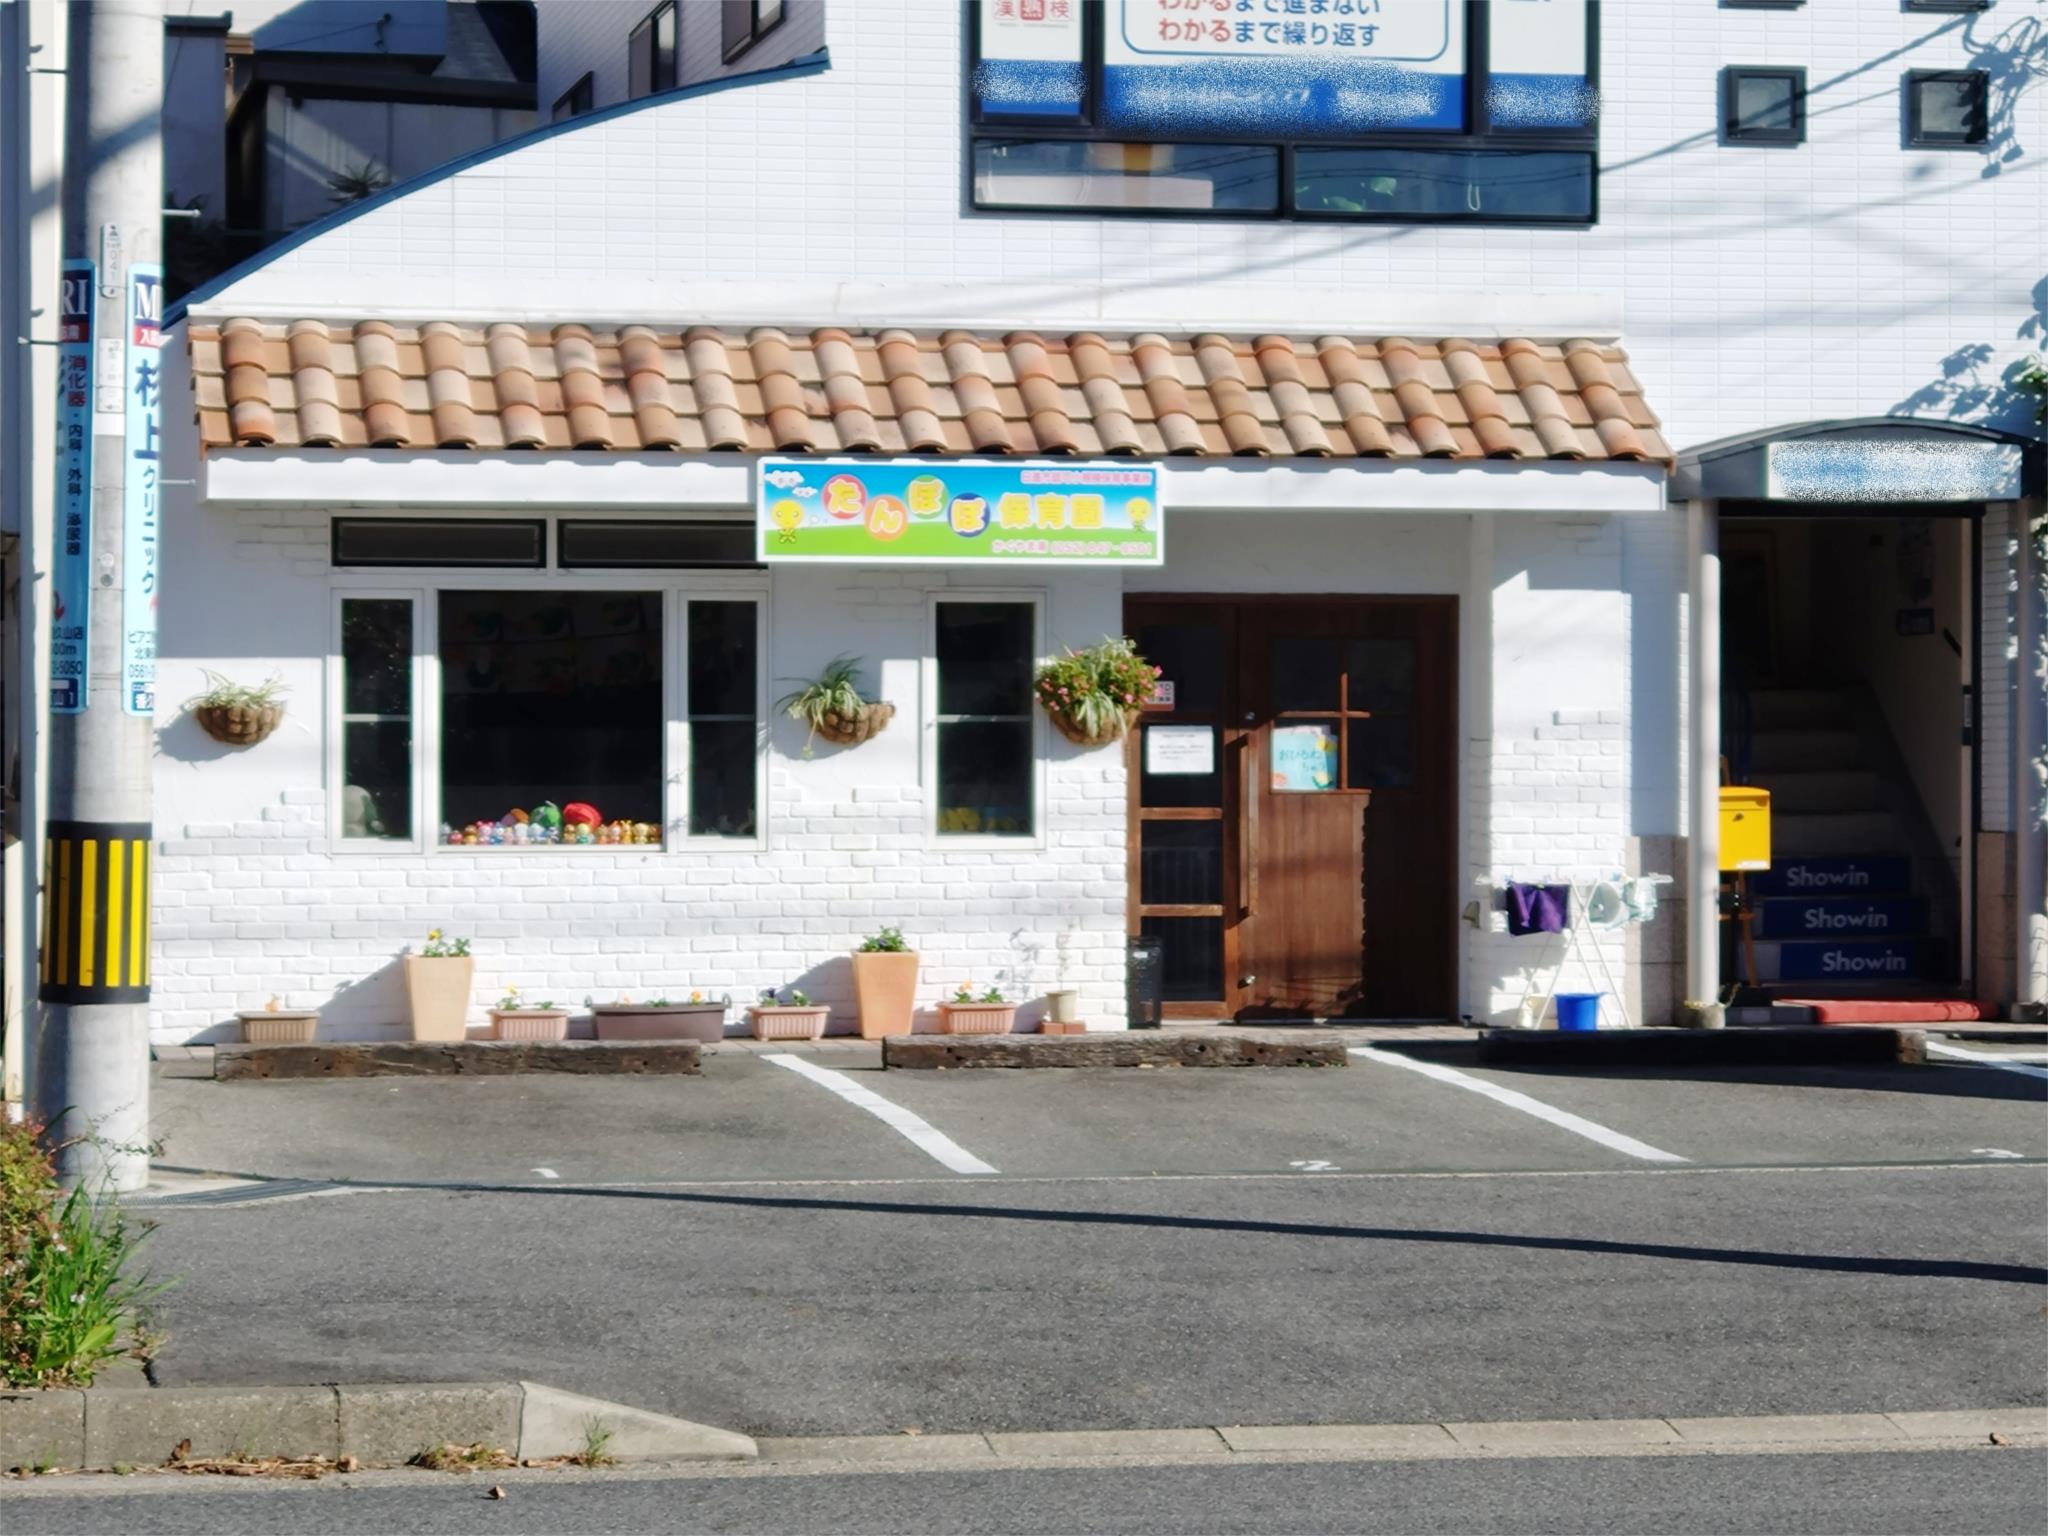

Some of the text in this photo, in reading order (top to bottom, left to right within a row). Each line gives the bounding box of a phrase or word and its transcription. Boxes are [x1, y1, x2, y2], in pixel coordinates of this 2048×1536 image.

[1158, 18, 1380, 46] わかるまで繰り返す
[1786, 865, 1870, 887] Showin
[1804, 907, 1888, 929] Showin
[1822, 950, 1907, 972] Showin
